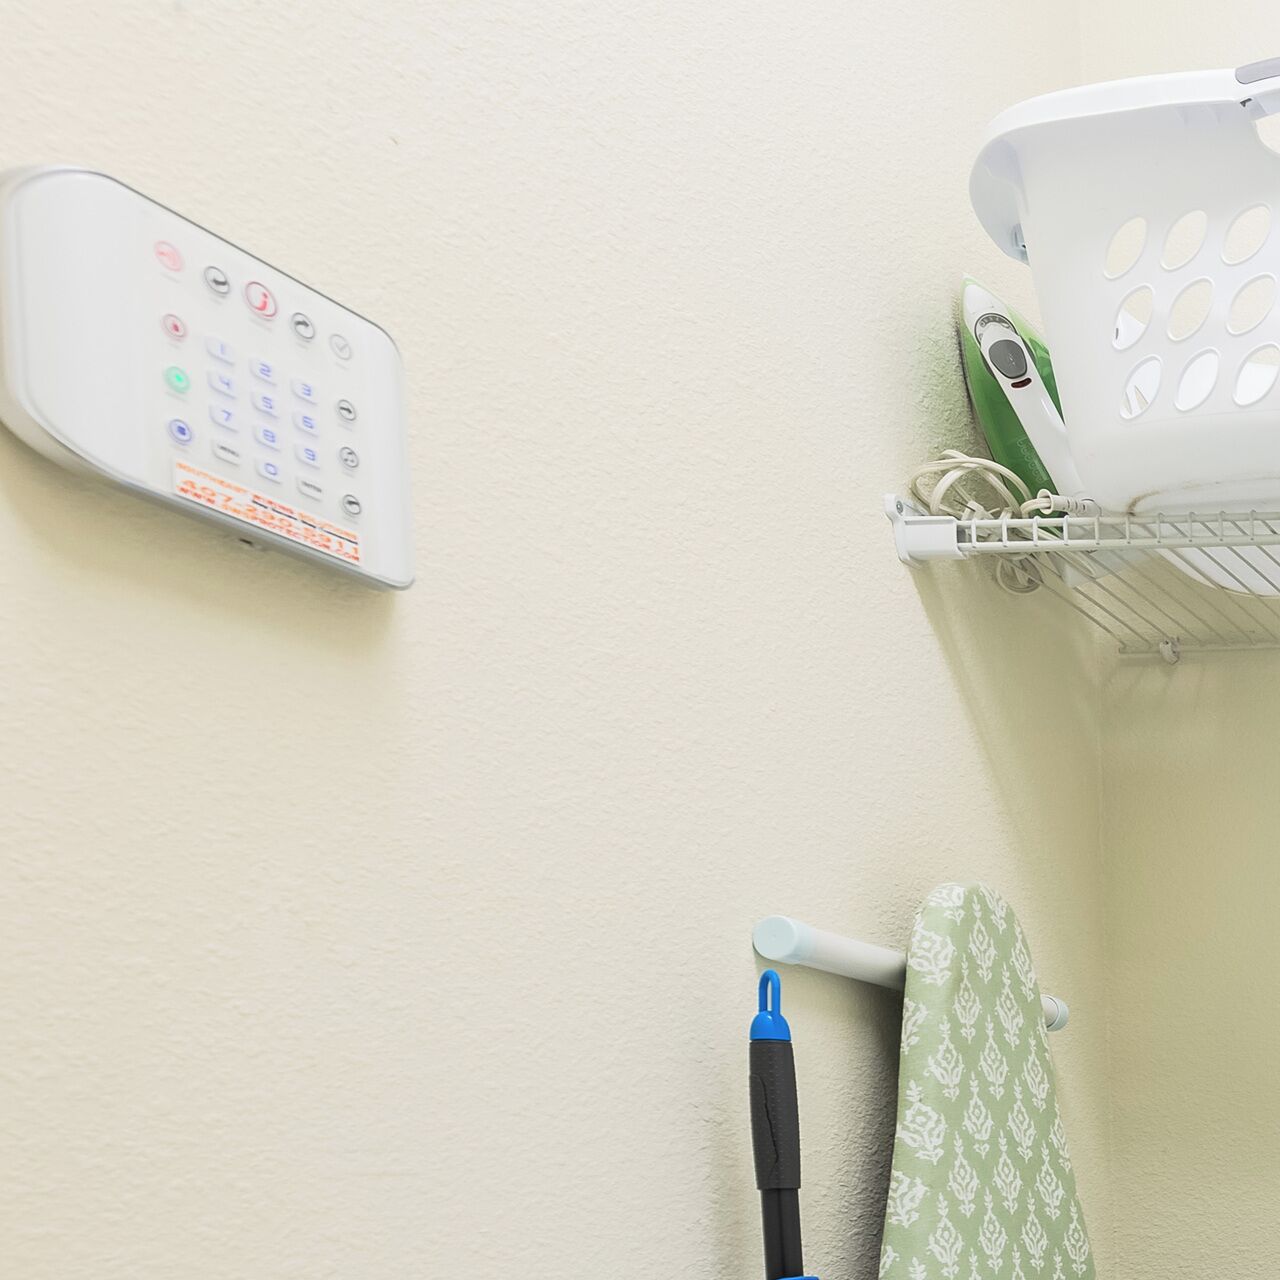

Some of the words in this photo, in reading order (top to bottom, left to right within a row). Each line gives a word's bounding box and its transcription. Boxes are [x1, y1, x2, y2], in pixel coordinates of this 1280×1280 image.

[259, 362, 272, 376] 2
[301, 383, 312, 398] 3
[262, 395, 274, 411] 5
[221, 408, 232, 422] 7
[303, 415, 315, 430] 6
[263, 428, 277, 444] 8
